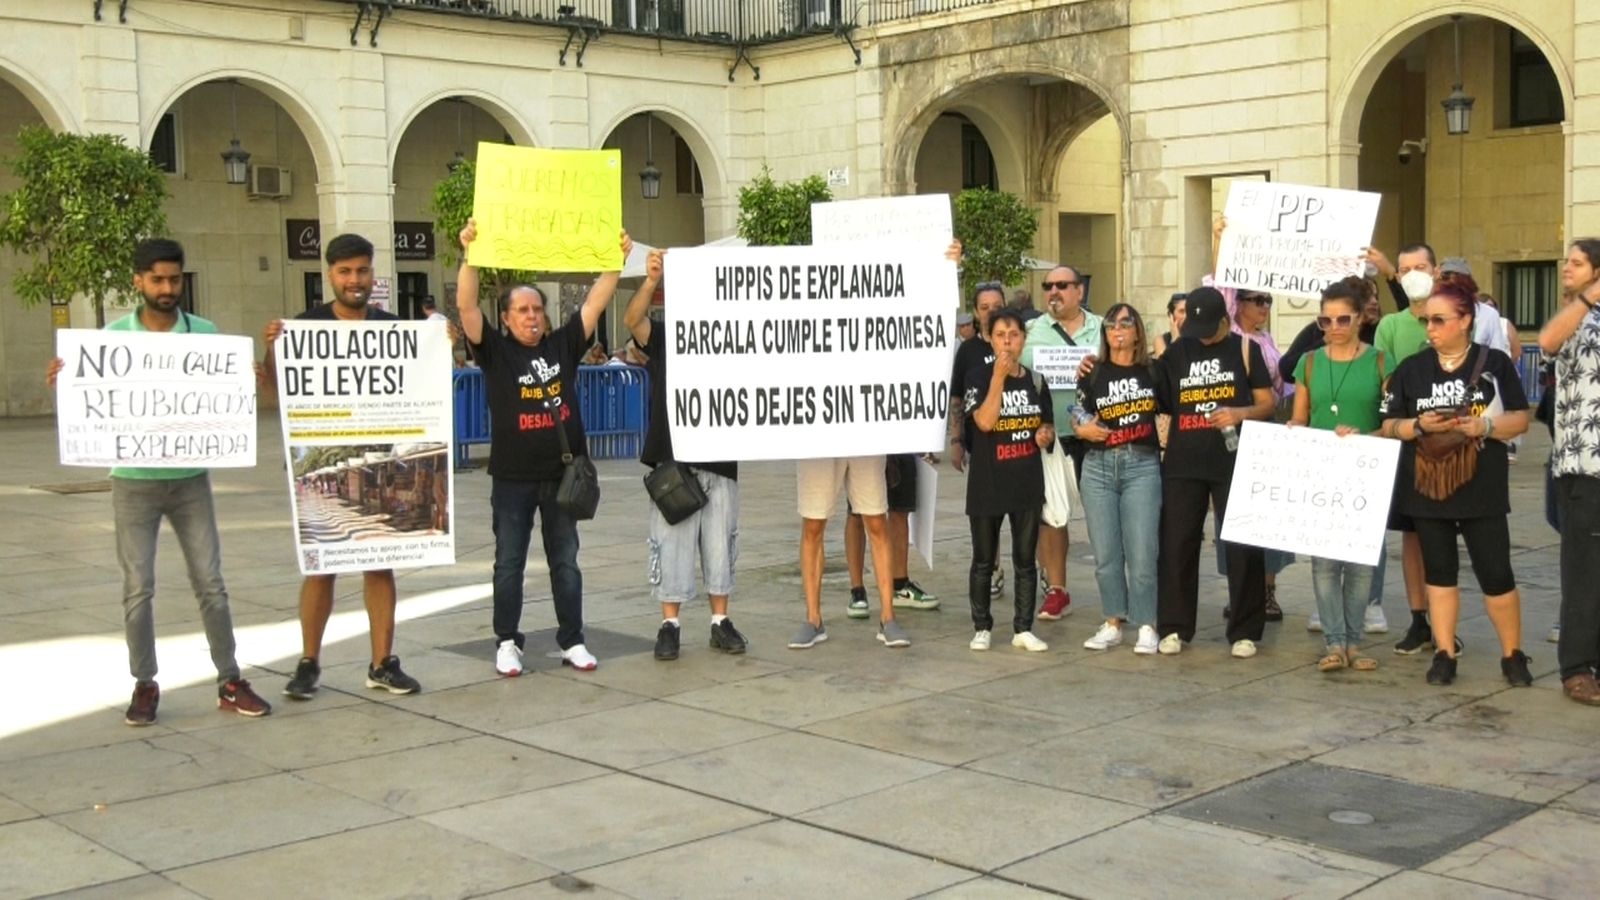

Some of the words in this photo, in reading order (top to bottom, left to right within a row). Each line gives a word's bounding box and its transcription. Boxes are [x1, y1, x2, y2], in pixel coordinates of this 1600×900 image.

[478, 202, 616, 235] TRABAJAR
[1268, 191, 1324, 233] PP
[415, 233, 427, 249] 2
[715, 265, 773, 301] HIPPIS
[779, 265, 801, 300] DE
[807, 263, 905, 300] EXPLANADA
[1225, 267, 1249, 285] NO
[283, 323, 418, 360] ¡VIOLACIÓN
[676, 320, 757, 355] BARCALA
[762, 318, 832, 354] CUMPLE
[837, 317, 859, 352] TU
[865, 314, 946, 351] PROMESA
[75, 344, 133, 379] NO
[143, 353, 153, 370] A
[159, 354, 175, 370] LA
[182, 351, 238, 376] CALLE
[1190, 358, 1220, 378] NOS
[284, 366, 315, 396] DE
[323, 365, 404, 396] LEYES!
[1108, 377, 1139, 395] NOS
[1432, 379, 1465, 397] NOS
[84, 386, 257, 419] REUBICACIÓN
[675, 387, 701, 428] NO
[708, 387, 749, 427] NOS
[755, 386, 816, 426] DEJES
[822, 384, 854, 425] SIN
[860, 380, 948, 423] TRABAJO
[1002, 389, 1028, 408] NOS
[1119, 413, 1139, 426] NO
[116, 433, 248, 460] EXPLANADA
[1012, 430, 1030, 442] NO
[1250, 481, 1368, 512] PELIGRO
[324, 558, 355, 568] podemos
[356, 556, 376, 565] hacer
[377, 555, 384, 563] la
